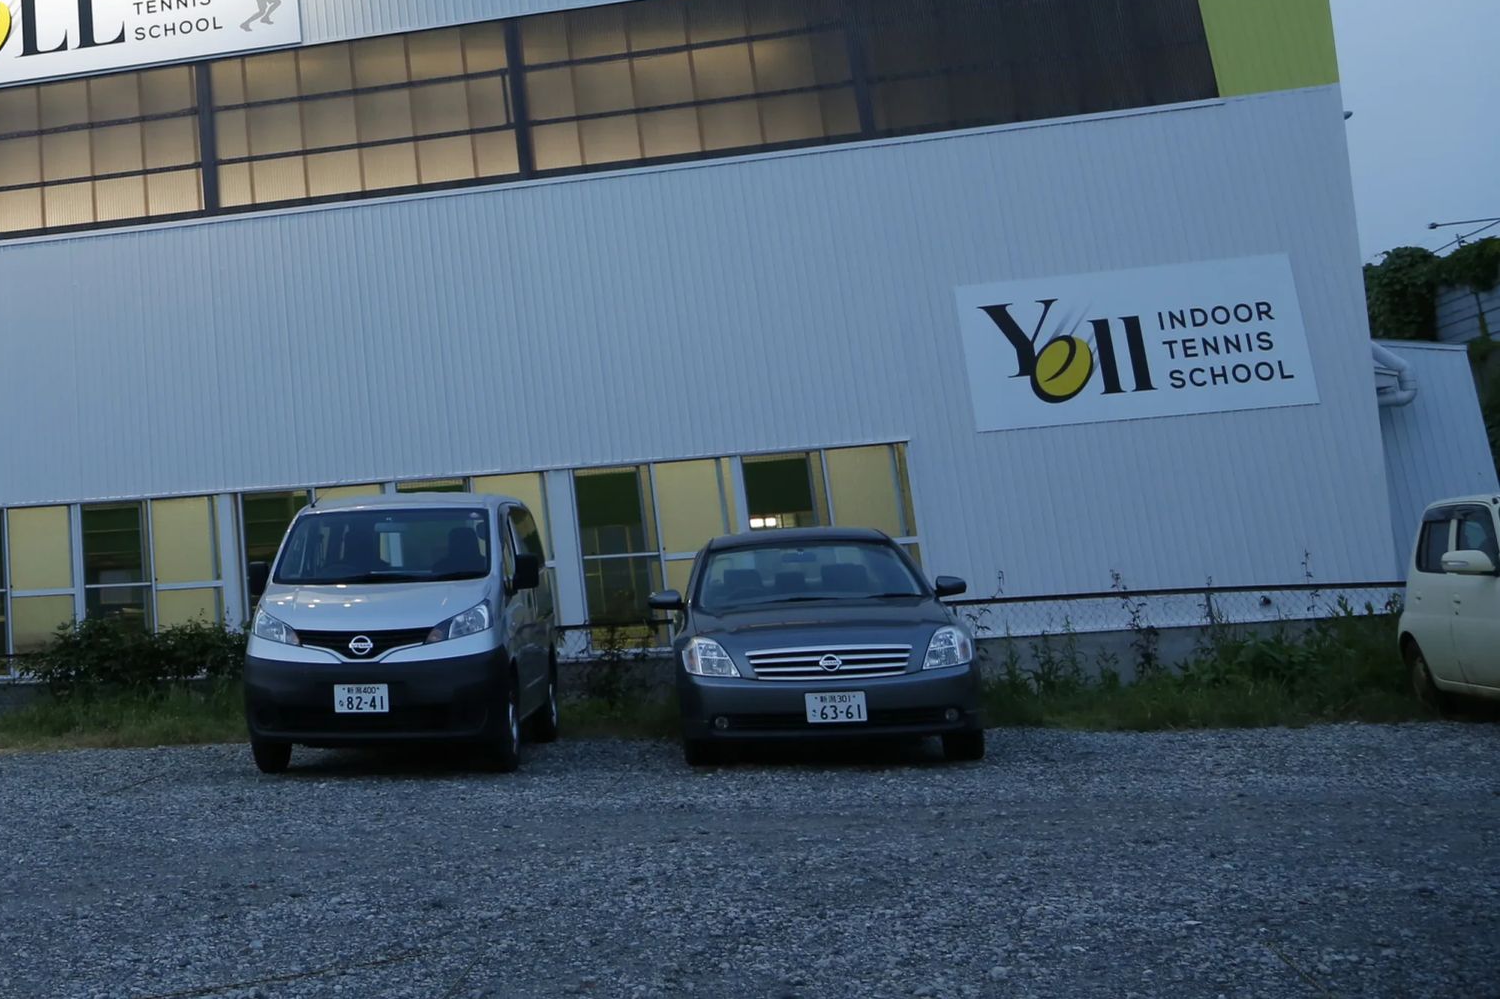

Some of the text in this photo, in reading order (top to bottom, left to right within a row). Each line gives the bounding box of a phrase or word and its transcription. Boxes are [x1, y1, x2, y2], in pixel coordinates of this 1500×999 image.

[134, 16, 223, 42] SCHOOL
[1157, 301, 1275, 331] INDOOR
[1162, 331, 1274, 360] TENNIS
[1169, 360, 1295, 389] SCHOOL
[346, 696, 384, 710] 82-41
[820, 704, 861, 720] 63-61
